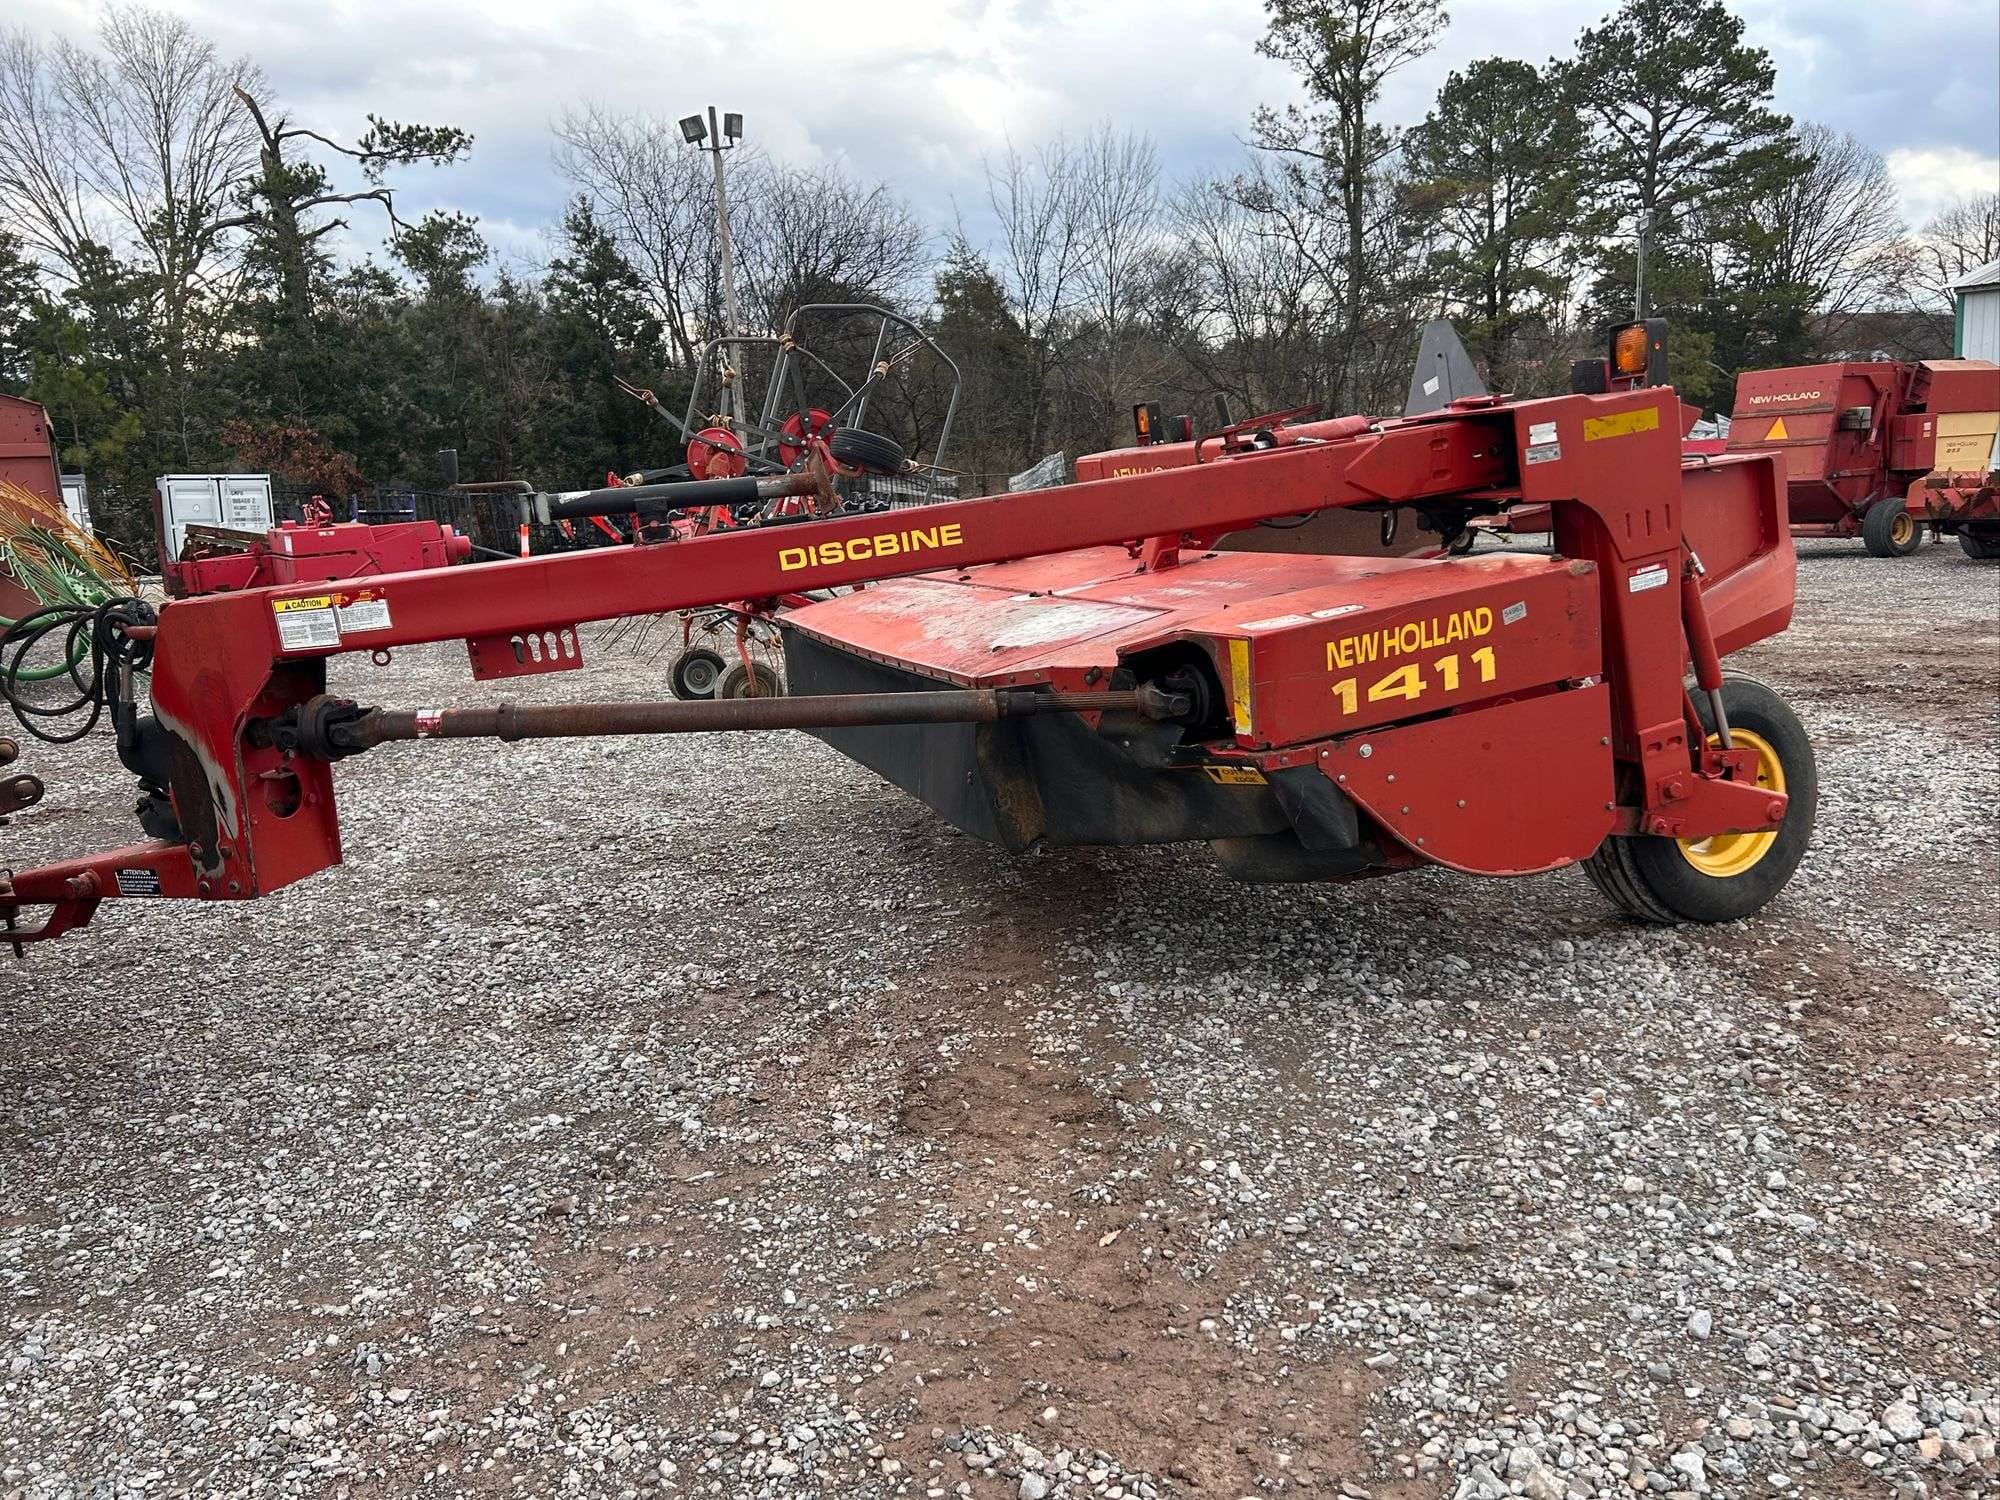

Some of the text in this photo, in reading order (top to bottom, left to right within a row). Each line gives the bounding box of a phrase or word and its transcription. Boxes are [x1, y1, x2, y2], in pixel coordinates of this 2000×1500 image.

[1749, 391, 1820, 404] NEW HOLLAND
[778, 523, 964, 572] DISCBINE
[291, 599, 322, 609] CAUTION
[1326, 606, 1494, 672] NEW HOLLAND
[1331, 646, 1497, 716] 1411
